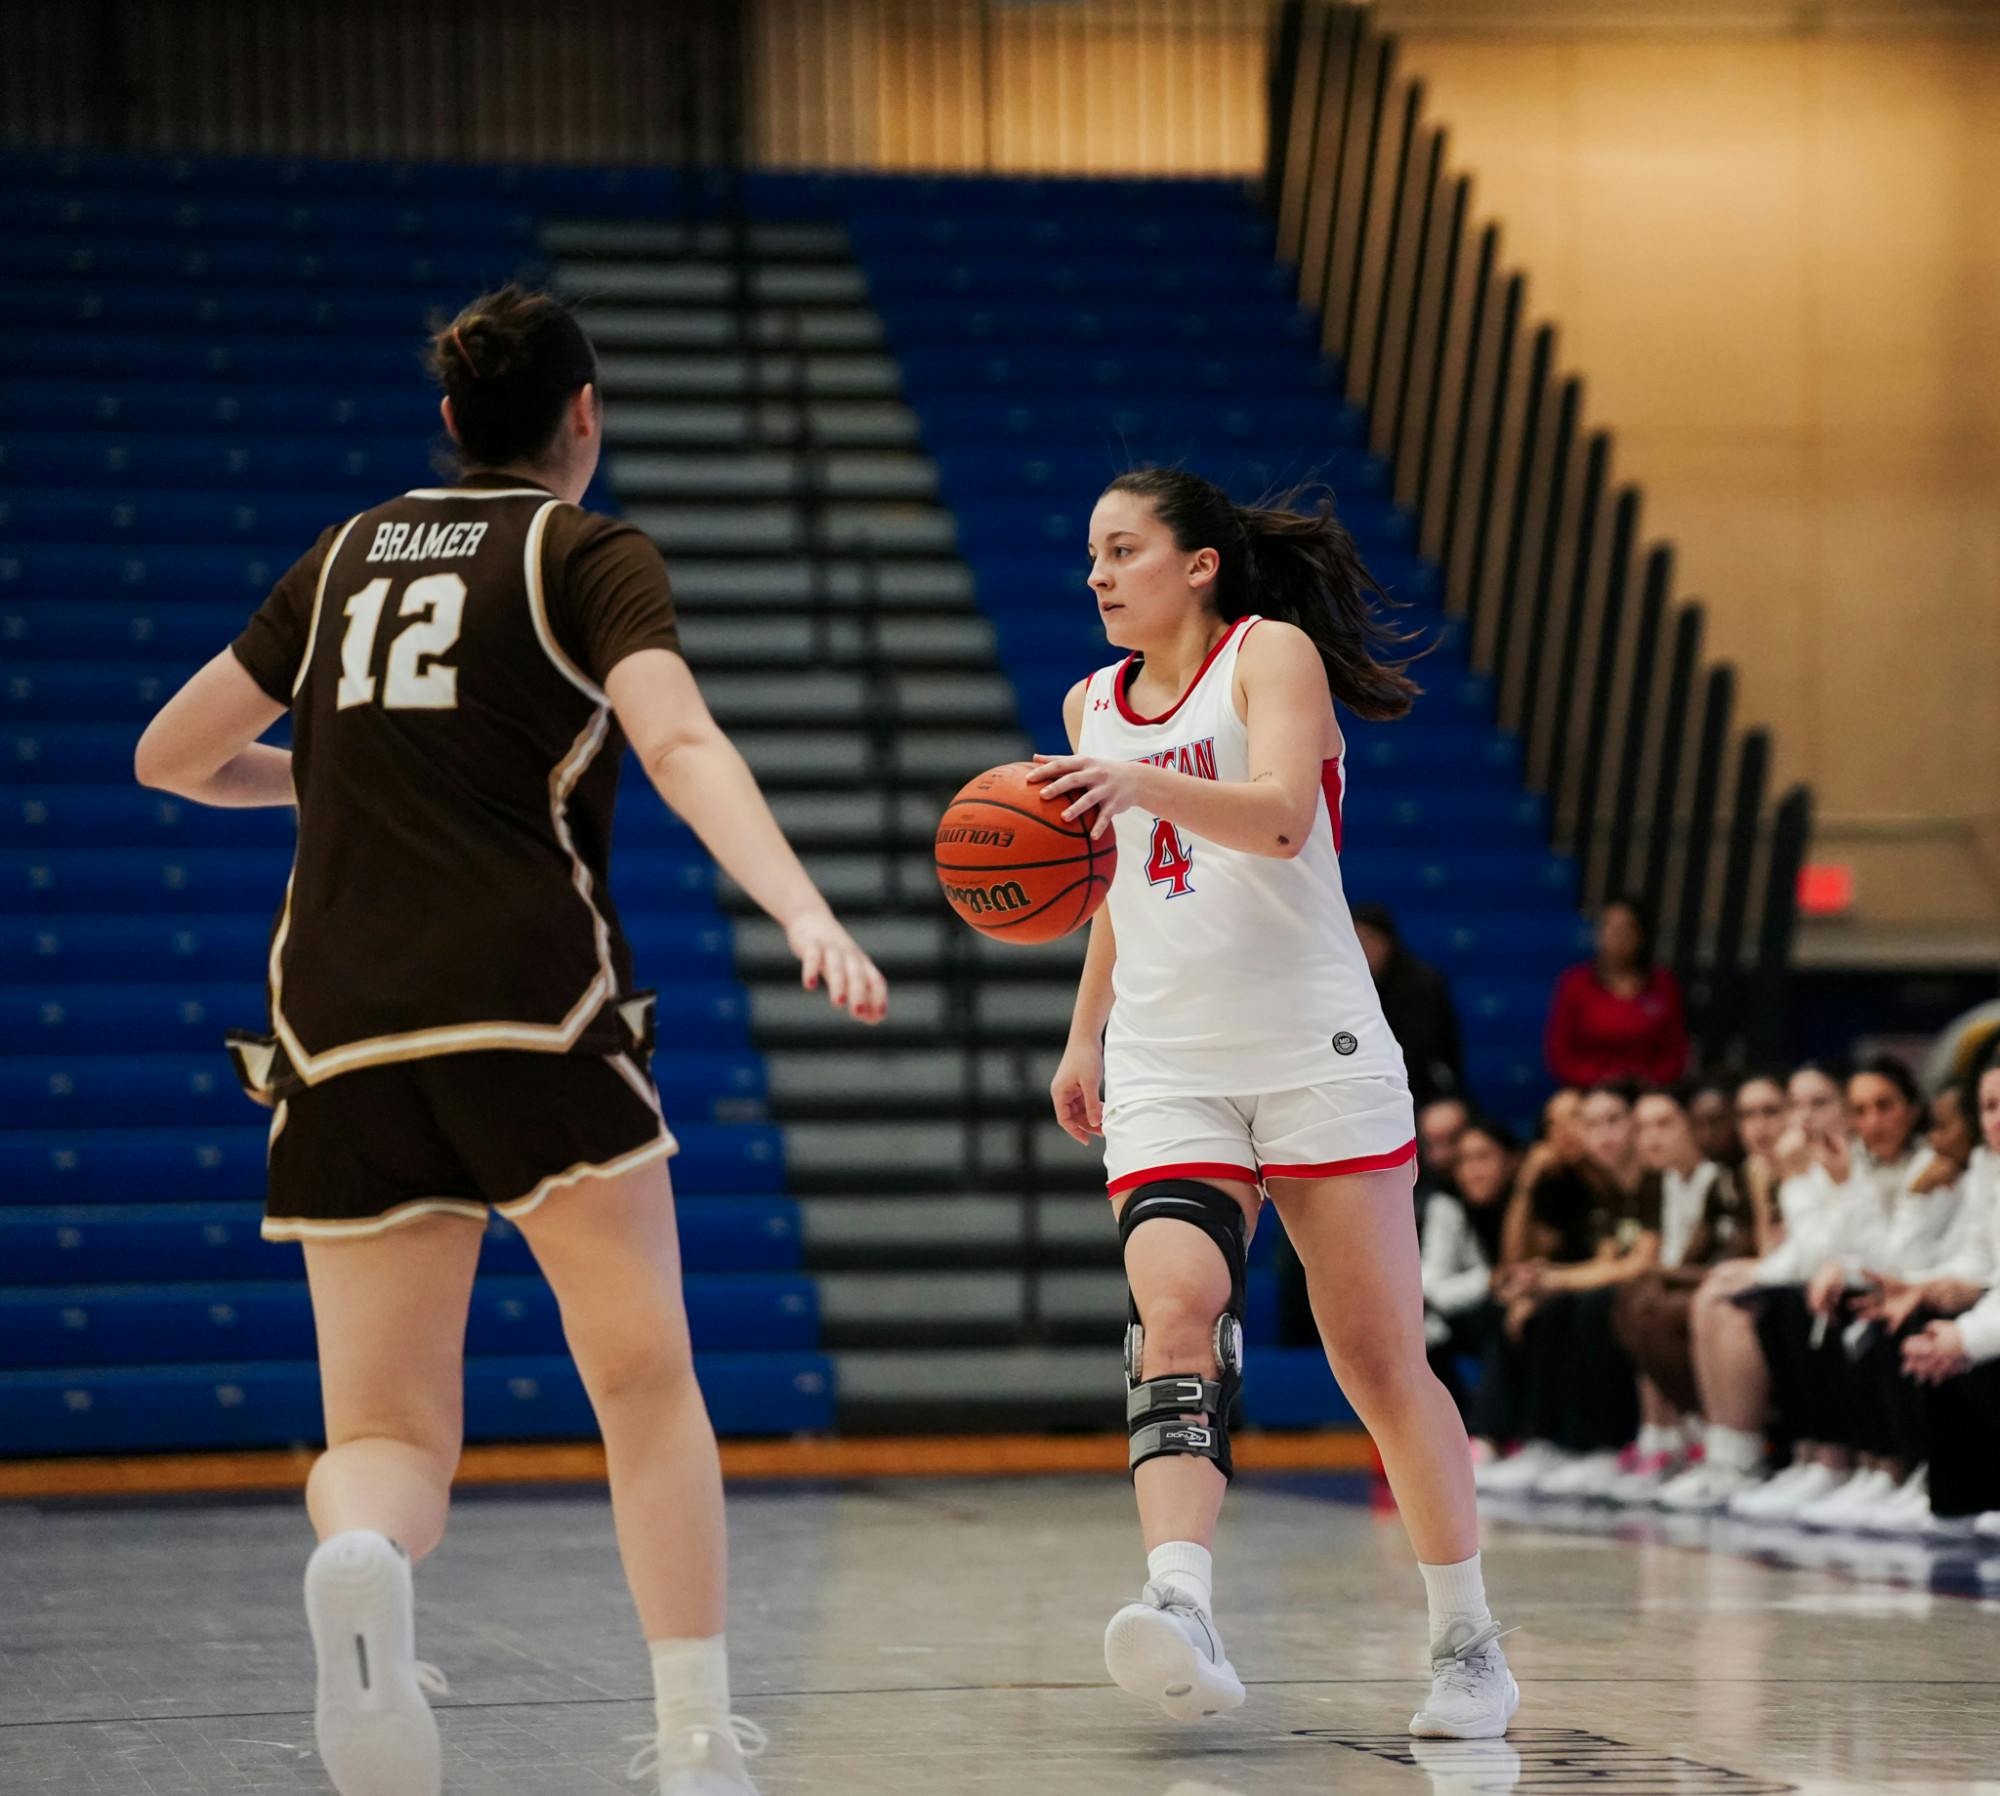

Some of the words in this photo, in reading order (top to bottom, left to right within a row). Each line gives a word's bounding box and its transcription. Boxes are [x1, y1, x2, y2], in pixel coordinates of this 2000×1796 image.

[366, 522, 488, 562] BRAMER
[336, 572, 468, 712] 12
[1144, 818, 1196, 900] 4
